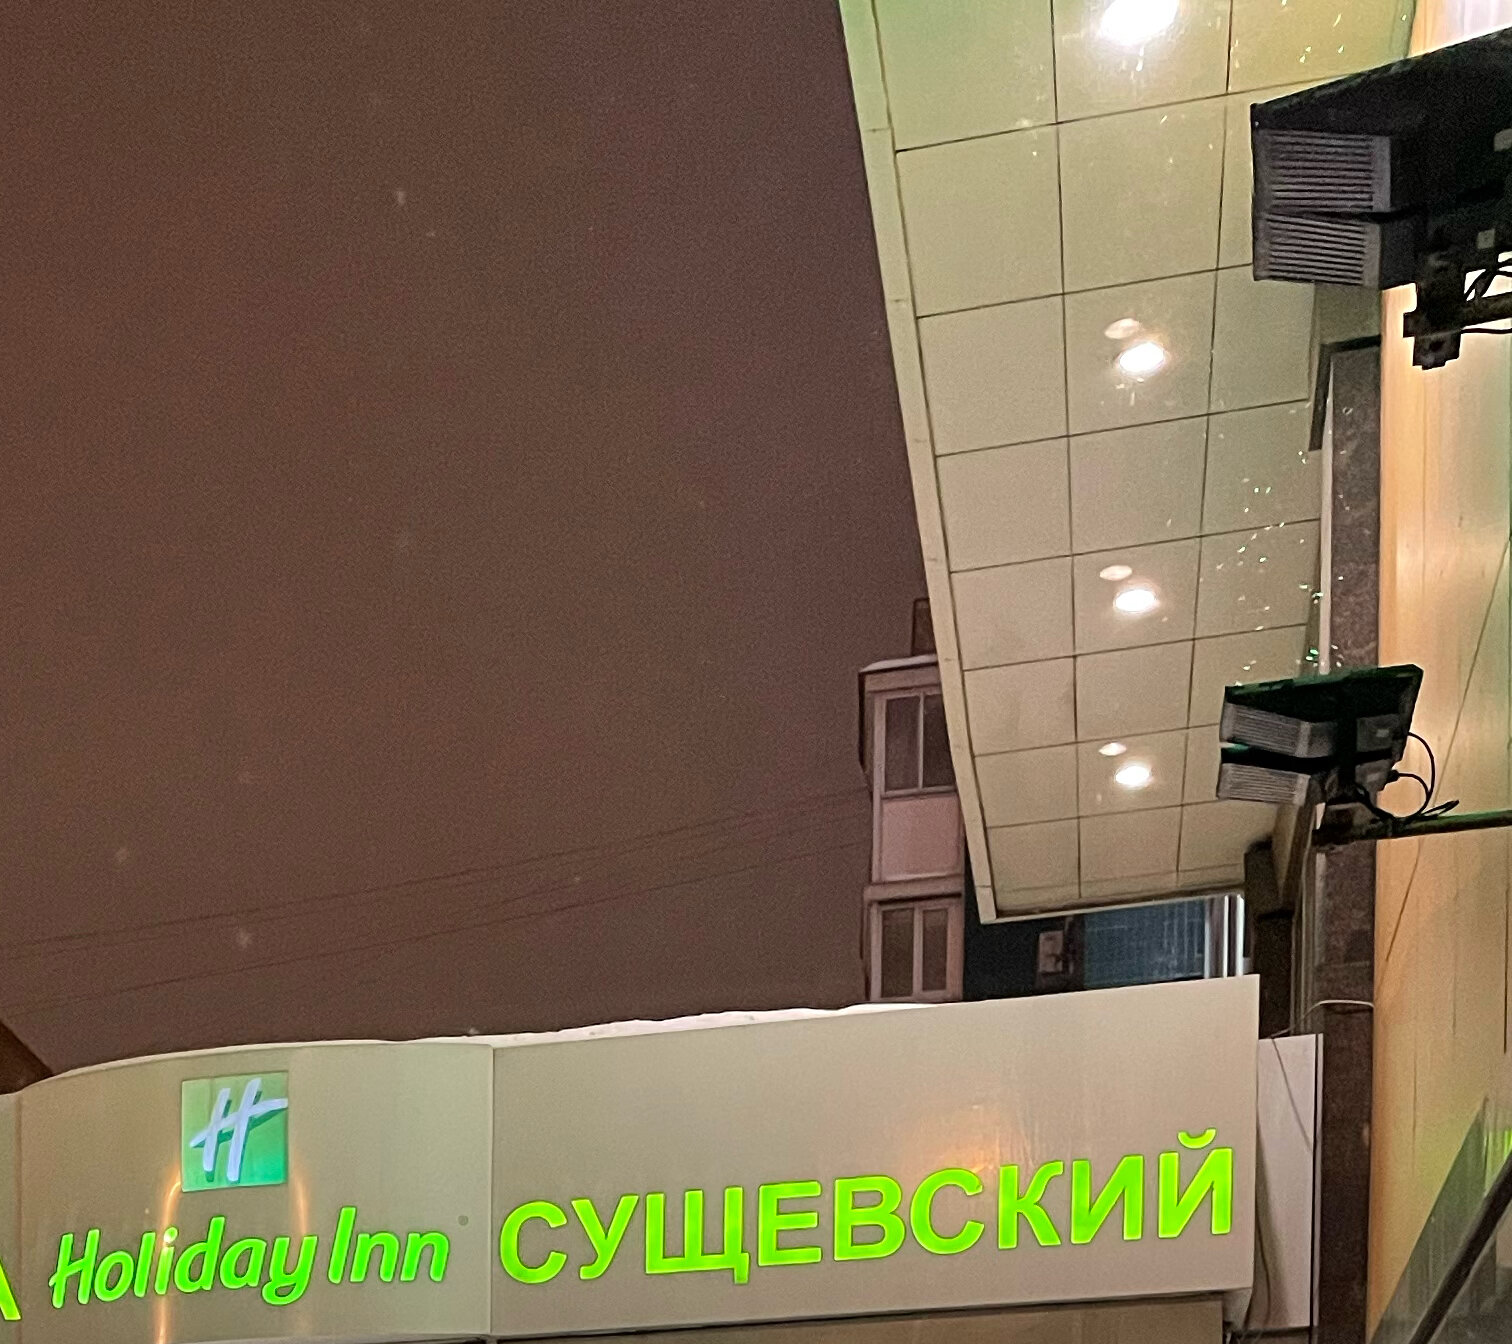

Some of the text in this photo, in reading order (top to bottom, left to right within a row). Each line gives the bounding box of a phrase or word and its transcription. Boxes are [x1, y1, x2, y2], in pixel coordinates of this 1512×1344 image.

[49, 1205, 450, 1306] Holiday Inn
[499, 1127, 1234, 1285] СУЩЕВСКИЙ
